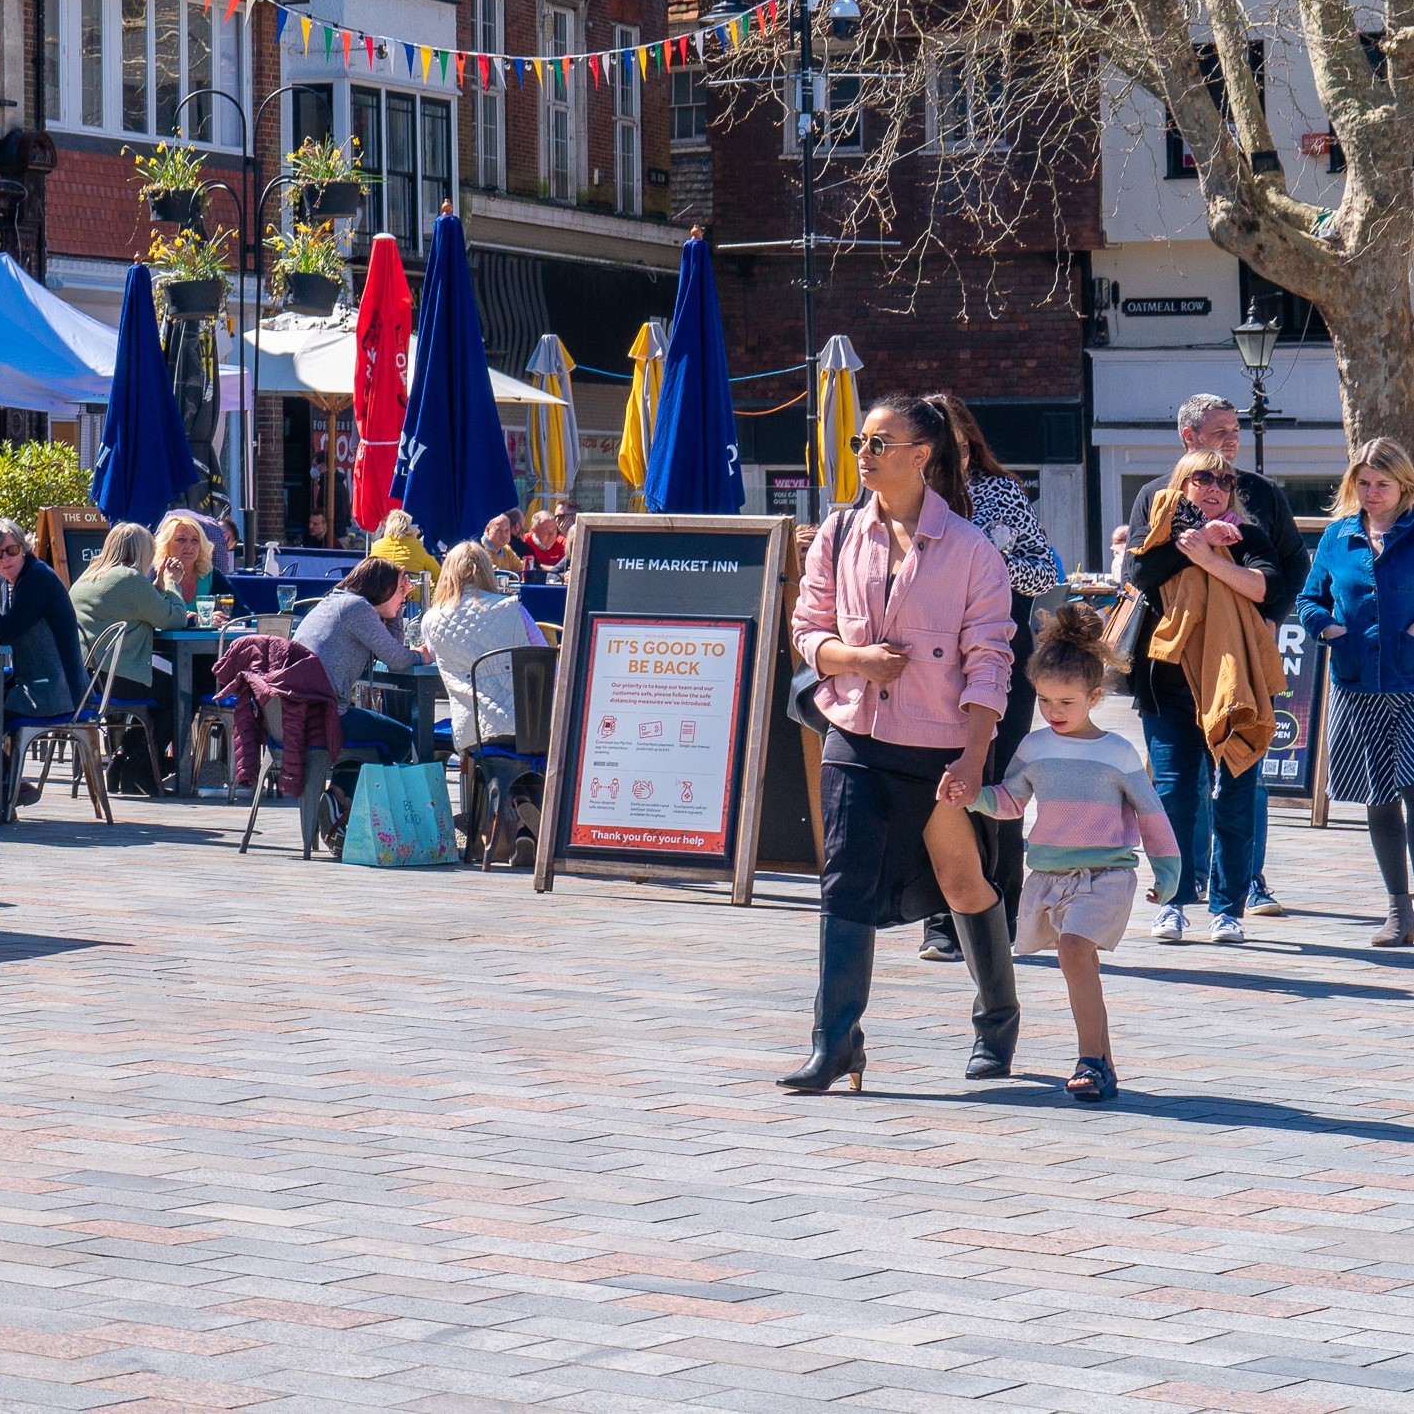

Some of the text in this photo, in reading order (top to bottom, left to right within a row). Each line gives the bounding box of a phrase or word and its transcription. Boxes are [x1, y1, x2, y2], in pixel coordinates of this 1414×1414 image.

[1127, 301, 1205, 313] OATMEAL ROW
[63, 512, 81, 522] THE
[84, 513, 98, 523] OX
[616, 558, 739, 573] THE MARKET INN
[607, 639, 726, 657] IT'S GOOD TO
[628, 659, 700, 676] BE BACK
[591, 829, 705, 846] Thank you for your help
